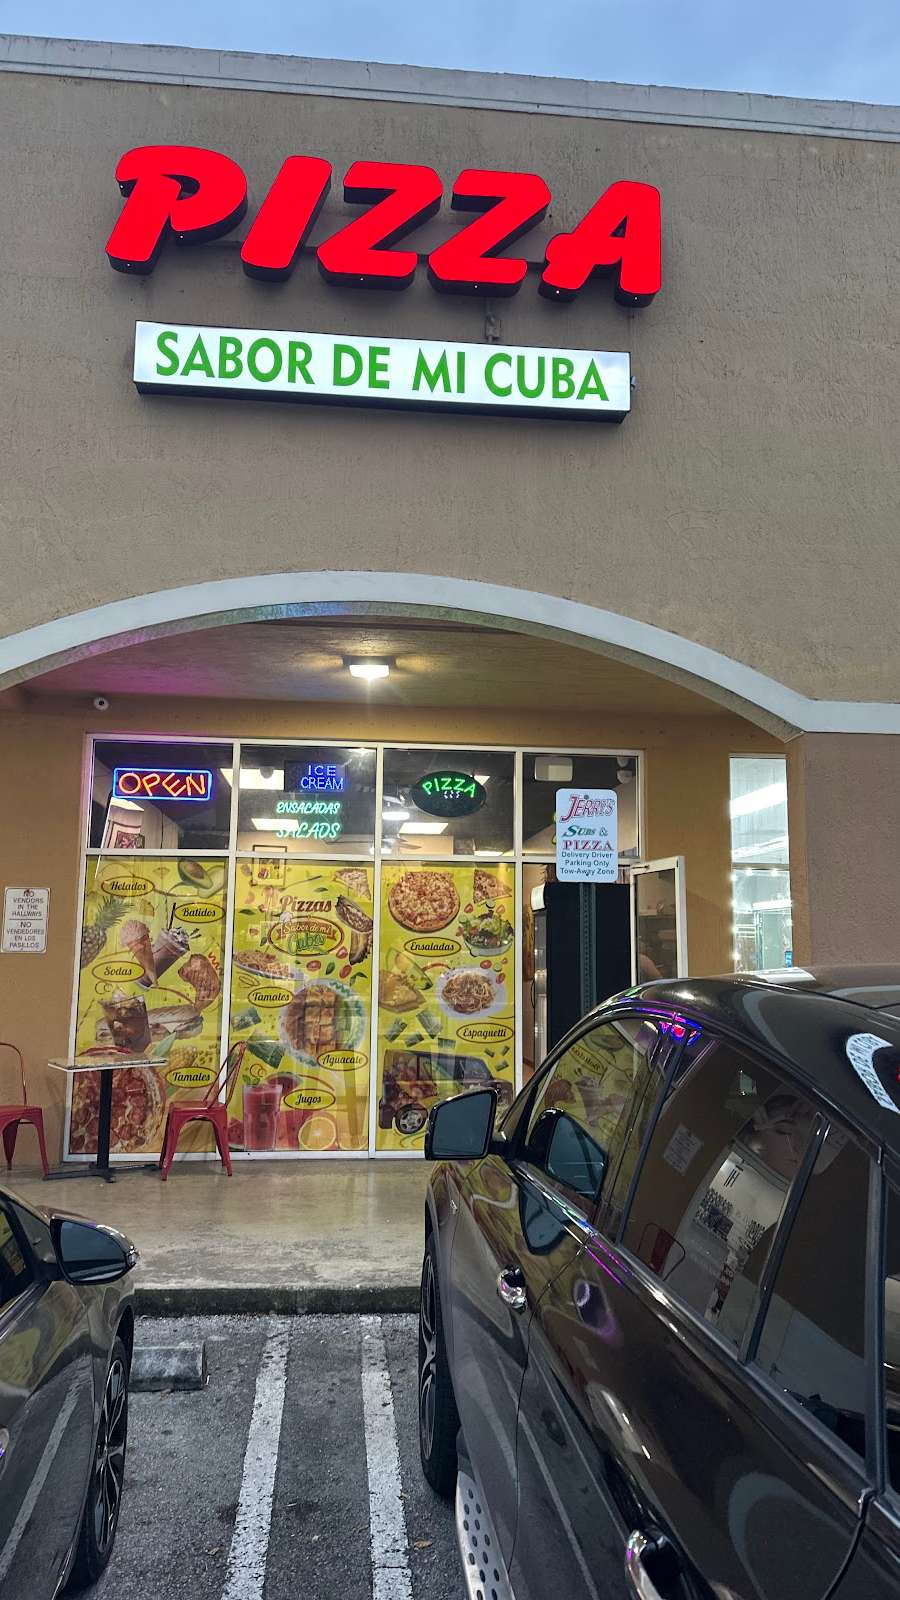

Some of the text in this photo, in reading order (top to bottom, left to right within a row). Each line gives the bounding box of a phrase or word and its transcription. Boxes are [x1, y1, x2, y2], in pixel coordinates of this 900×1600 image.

[105, 145, 662, 302] PIZZA
[156, 331, 609, 402] SABOR DE MI CUBA
[308, 764, 337, 776] ICE
[118, 772, 206, 797] OPEN
[300, 777, 344, 790] CREAM
[421, 777, 477, 799] PIZZA
[276, 801, 341, 815] ENSALADAS
[599, 827, 608, 837] &
[562, 840, 614, 852] PIZZA
[561, 852, 590, 860] Delivery
[564, 860, 610, 868] Parking Only
[560, 868, 596, 876] Tow-Away
[111, 880, 146, 889] Helados
[279, 895, 332, 912] Pizzas
[182, 908, 216, 917] Batidos
[410, 941, 455, 951] Ensaladas
[103, 966, 132, 976] Sodas
[251, 992, 290, 1001] Tamales
[462, 1027, 507, 1039] Espaguetti
[321, 1053, 363, 1066] Aguacate
[171, 1070, 210, 1082] Tamales
[294, 1093, 322, 1105] Jugos
